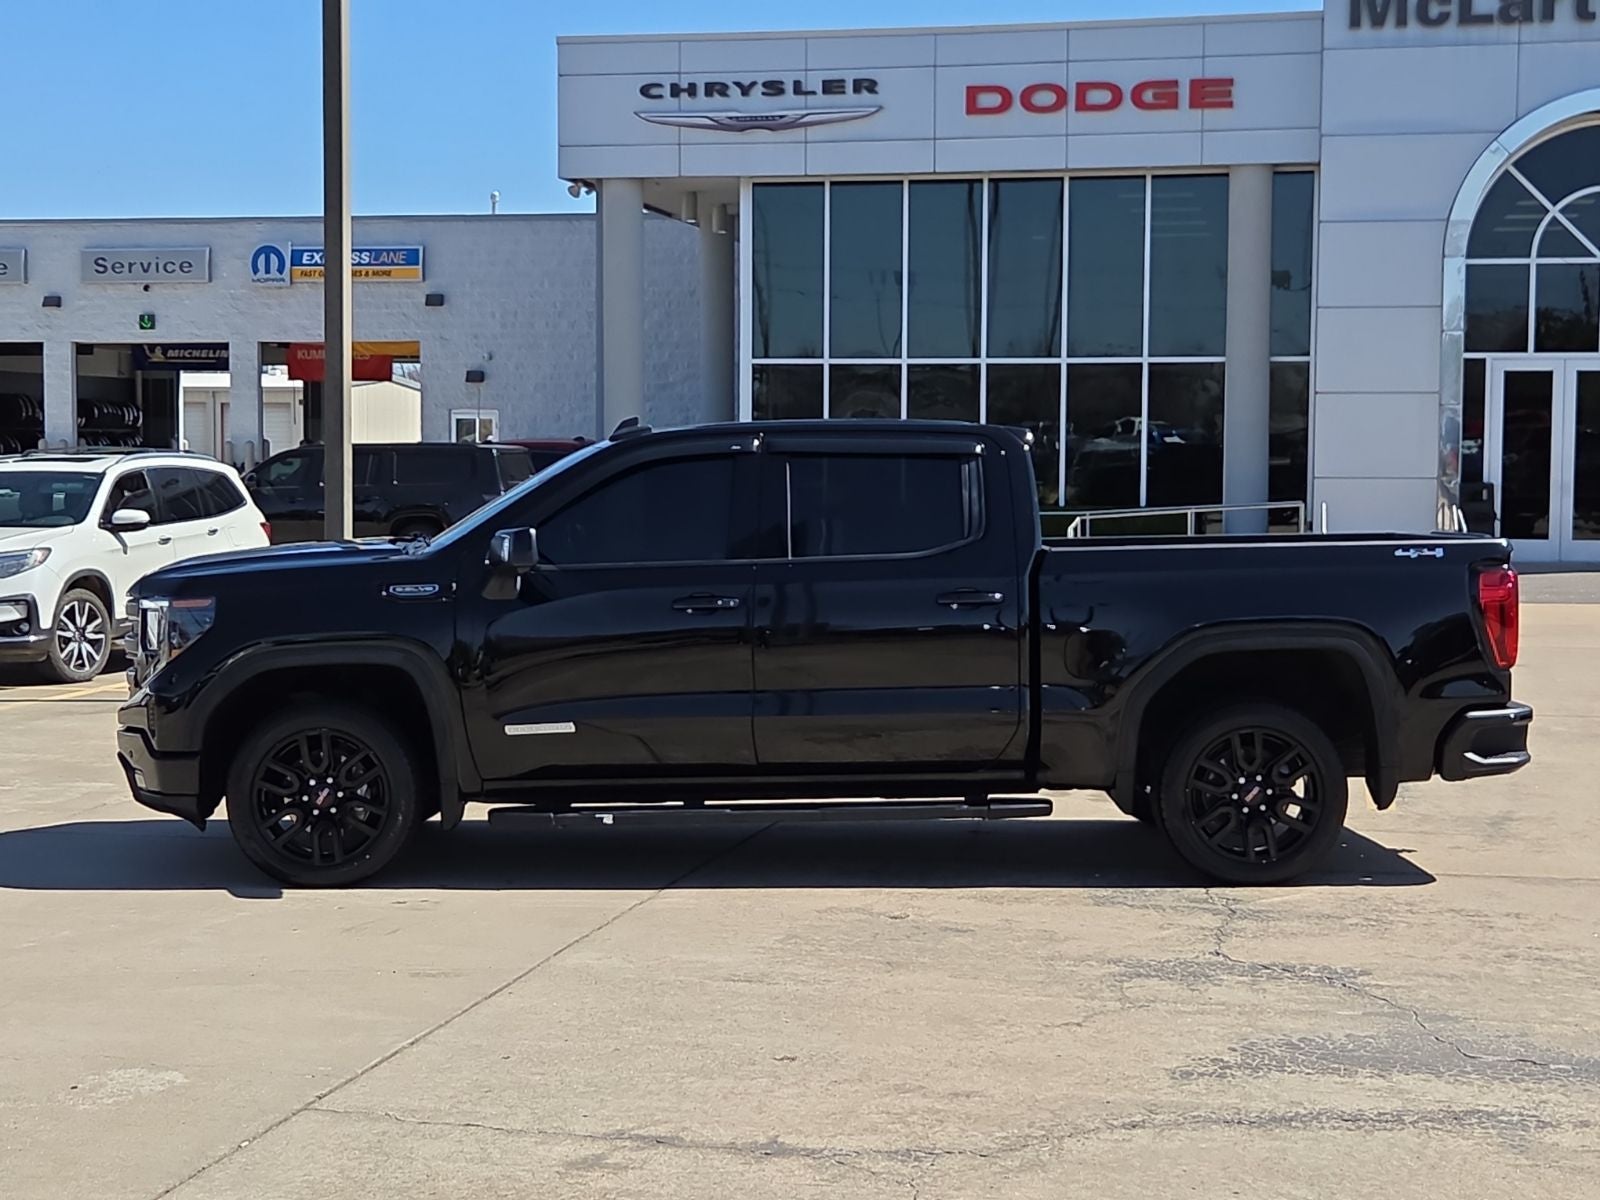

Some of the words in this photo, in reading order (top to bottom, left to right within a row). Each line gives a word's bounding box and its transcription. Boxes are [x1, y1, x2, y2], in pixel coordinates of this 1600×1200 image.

[1349, 0, 1597, 29] McLart
[639, 78, 879, 99] CHRYSLER
[965, 78, 1234, 116] DODGE
[93, 256, 194, 274] Service
[300, 269, 316, 278] FAST
[371, 269, 393, 278] MORE
[166, 349, 229, 358] MICHELIN
